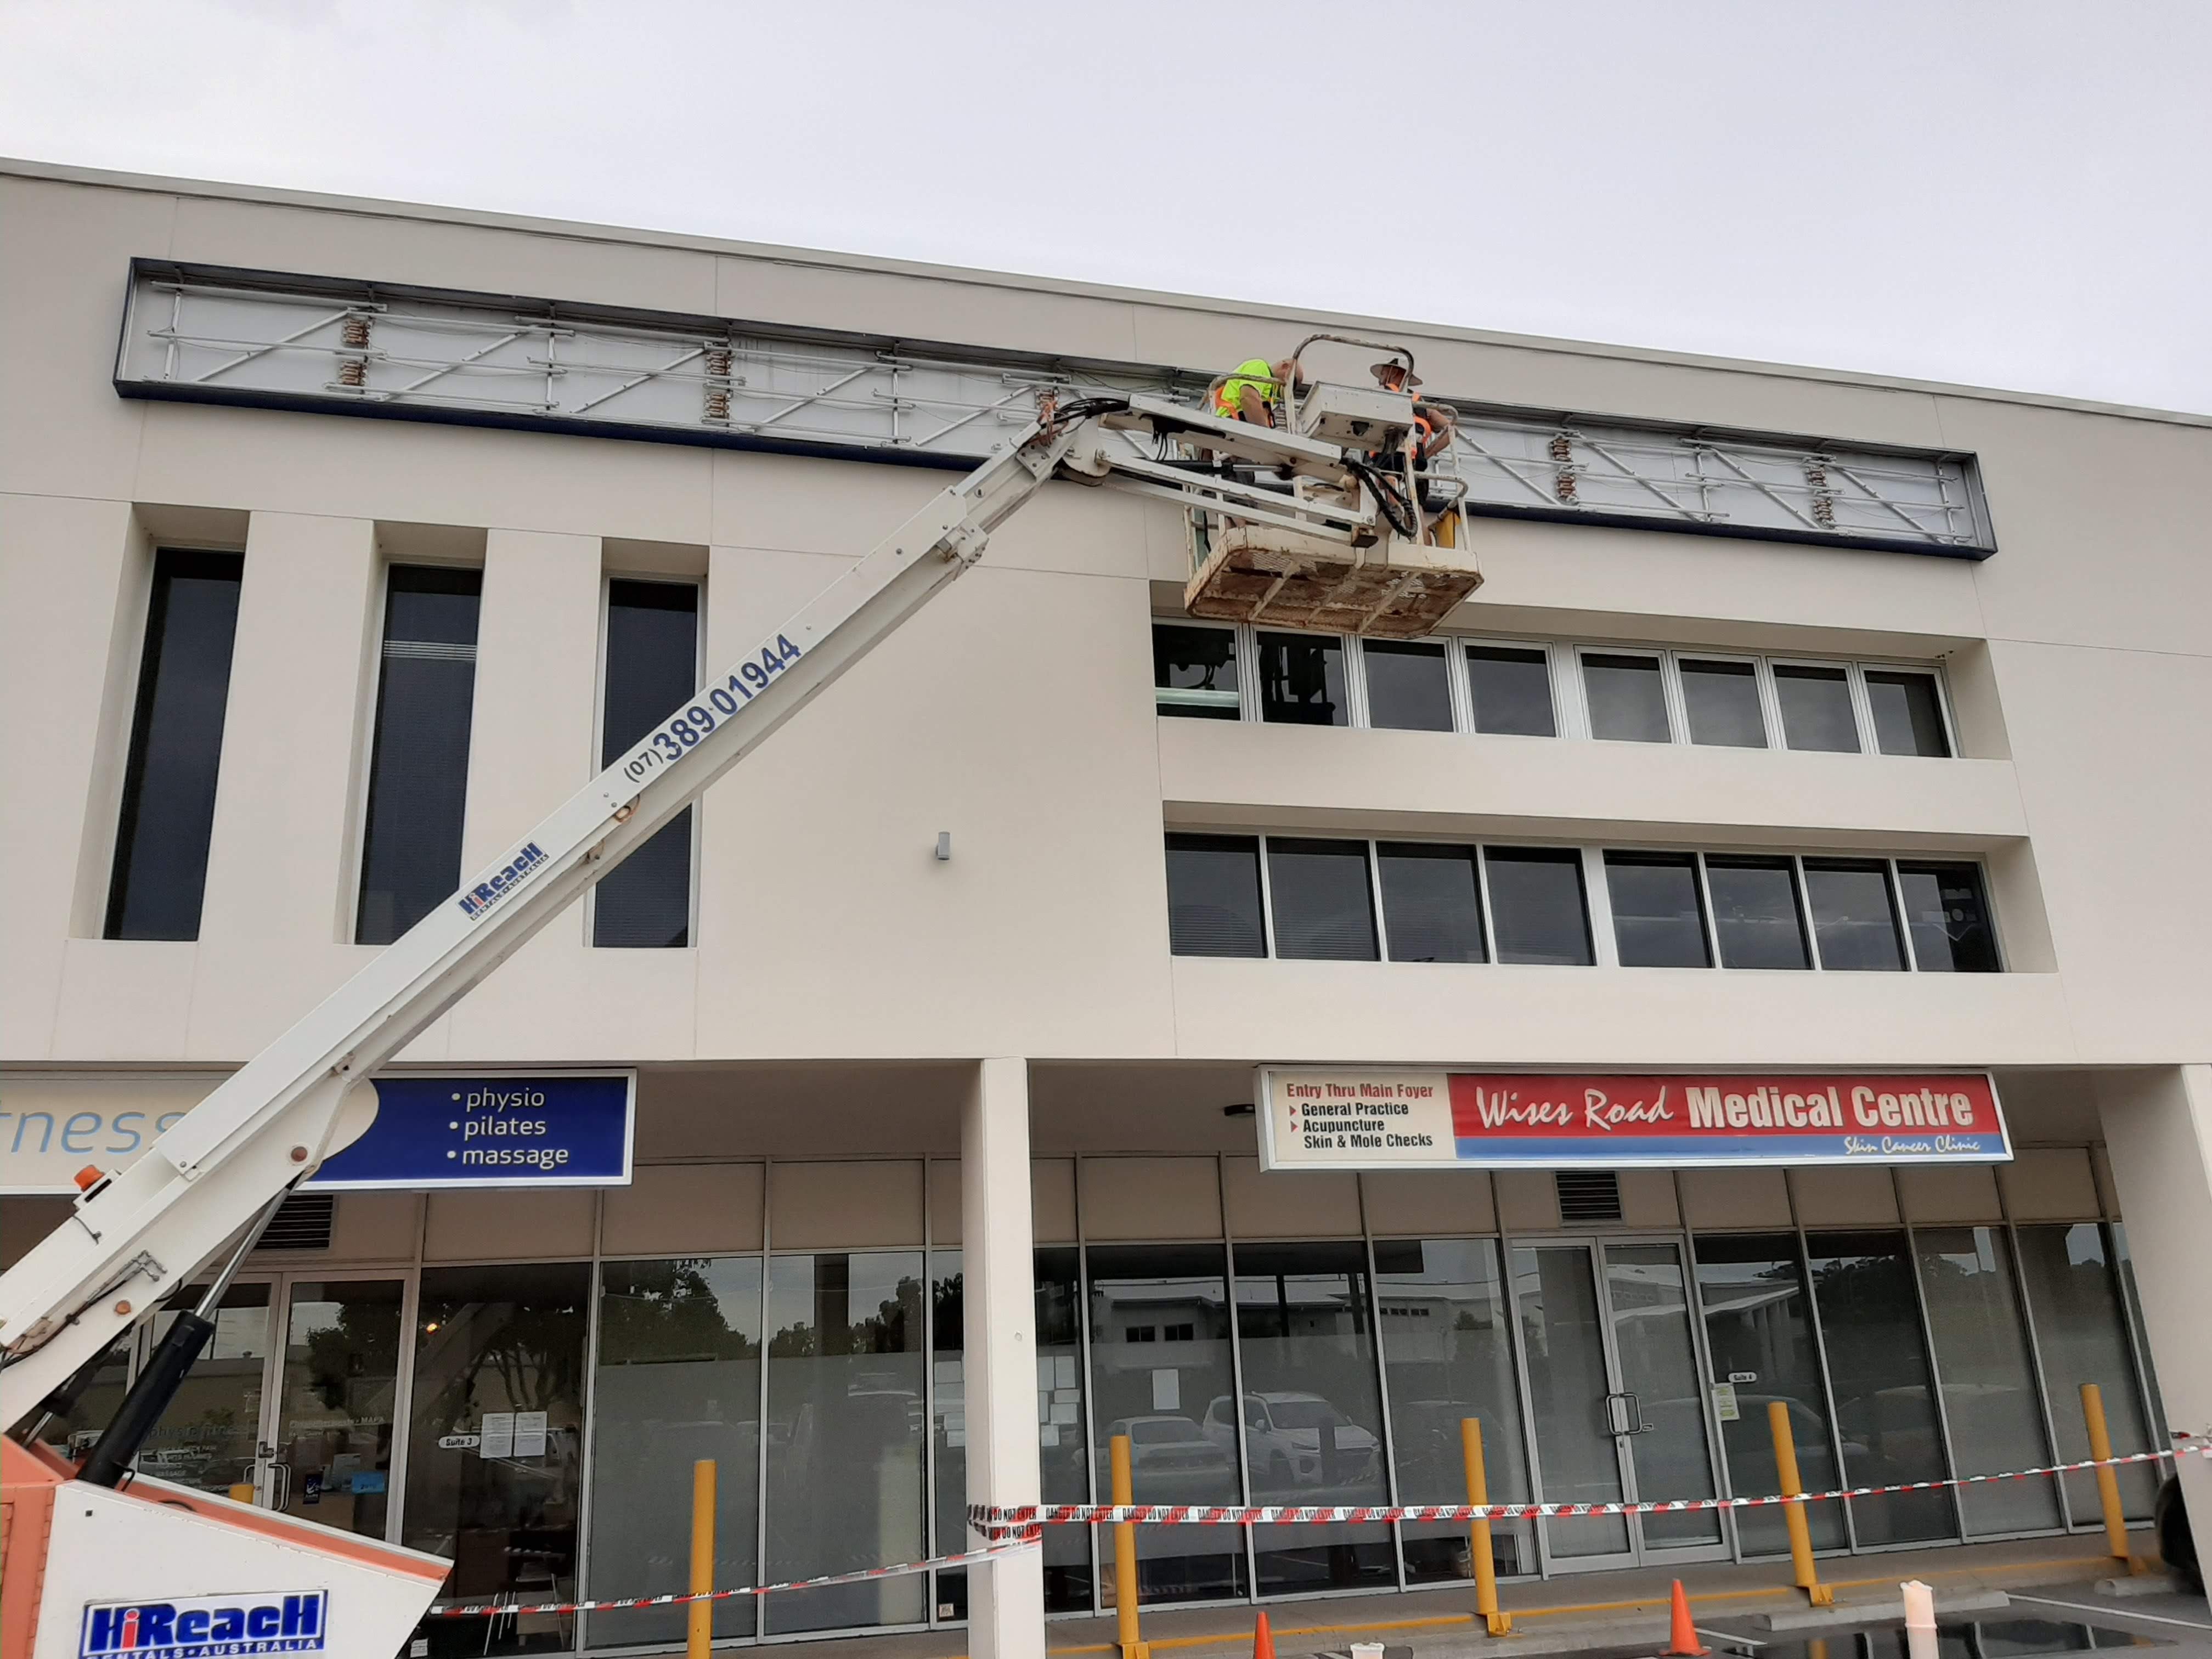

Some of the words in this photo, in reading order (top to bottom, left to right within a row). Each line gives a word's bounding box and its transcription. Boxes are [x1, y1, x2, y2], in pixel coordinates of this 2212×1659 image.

[1286, 1083, 1322, 1098] Entry
[1325, 1083, 1356, 1097] Thru
[1359, 1083, 1393, 1097] Main
[1398, 1084, 1434, 1099] Foyer
[466, 1087, 545, 1113] physio
[1476, 1086, 1573, 1129] Wises
[1584, 1085, 1674, 1131] Road
[1685, 1086, 1844, 1128] Medical
[1850, 1086, 1974, 1127] Centre
[1301, 1102, 1351, 1116] General
[1356, 1102, 1409, 1116] Practice
[464, 1115, 546, 1141] pilates
[1303, 1119, 1385, 1133] Acupuncture
[1304, 1135, 1333, 1149] Skin
[1336, 1136, 1346, 1148] &
[1351, 1135, 1382, 1148] Mole
[1386, 1133, 1433, 1147] Checks
[1844, 1136, 1878, 1155] Skin
[1881, 1136, 1932, 1154] Cancer
[1935, 1134, 1980, 1153] Clinic
[462, 1149, 569, 1170] massage
[467, 1437, 472, 1446] 3
[993, 1508, 1002, 1521] DO
[199, 1639, 317, 1657] AUSTRALIA
